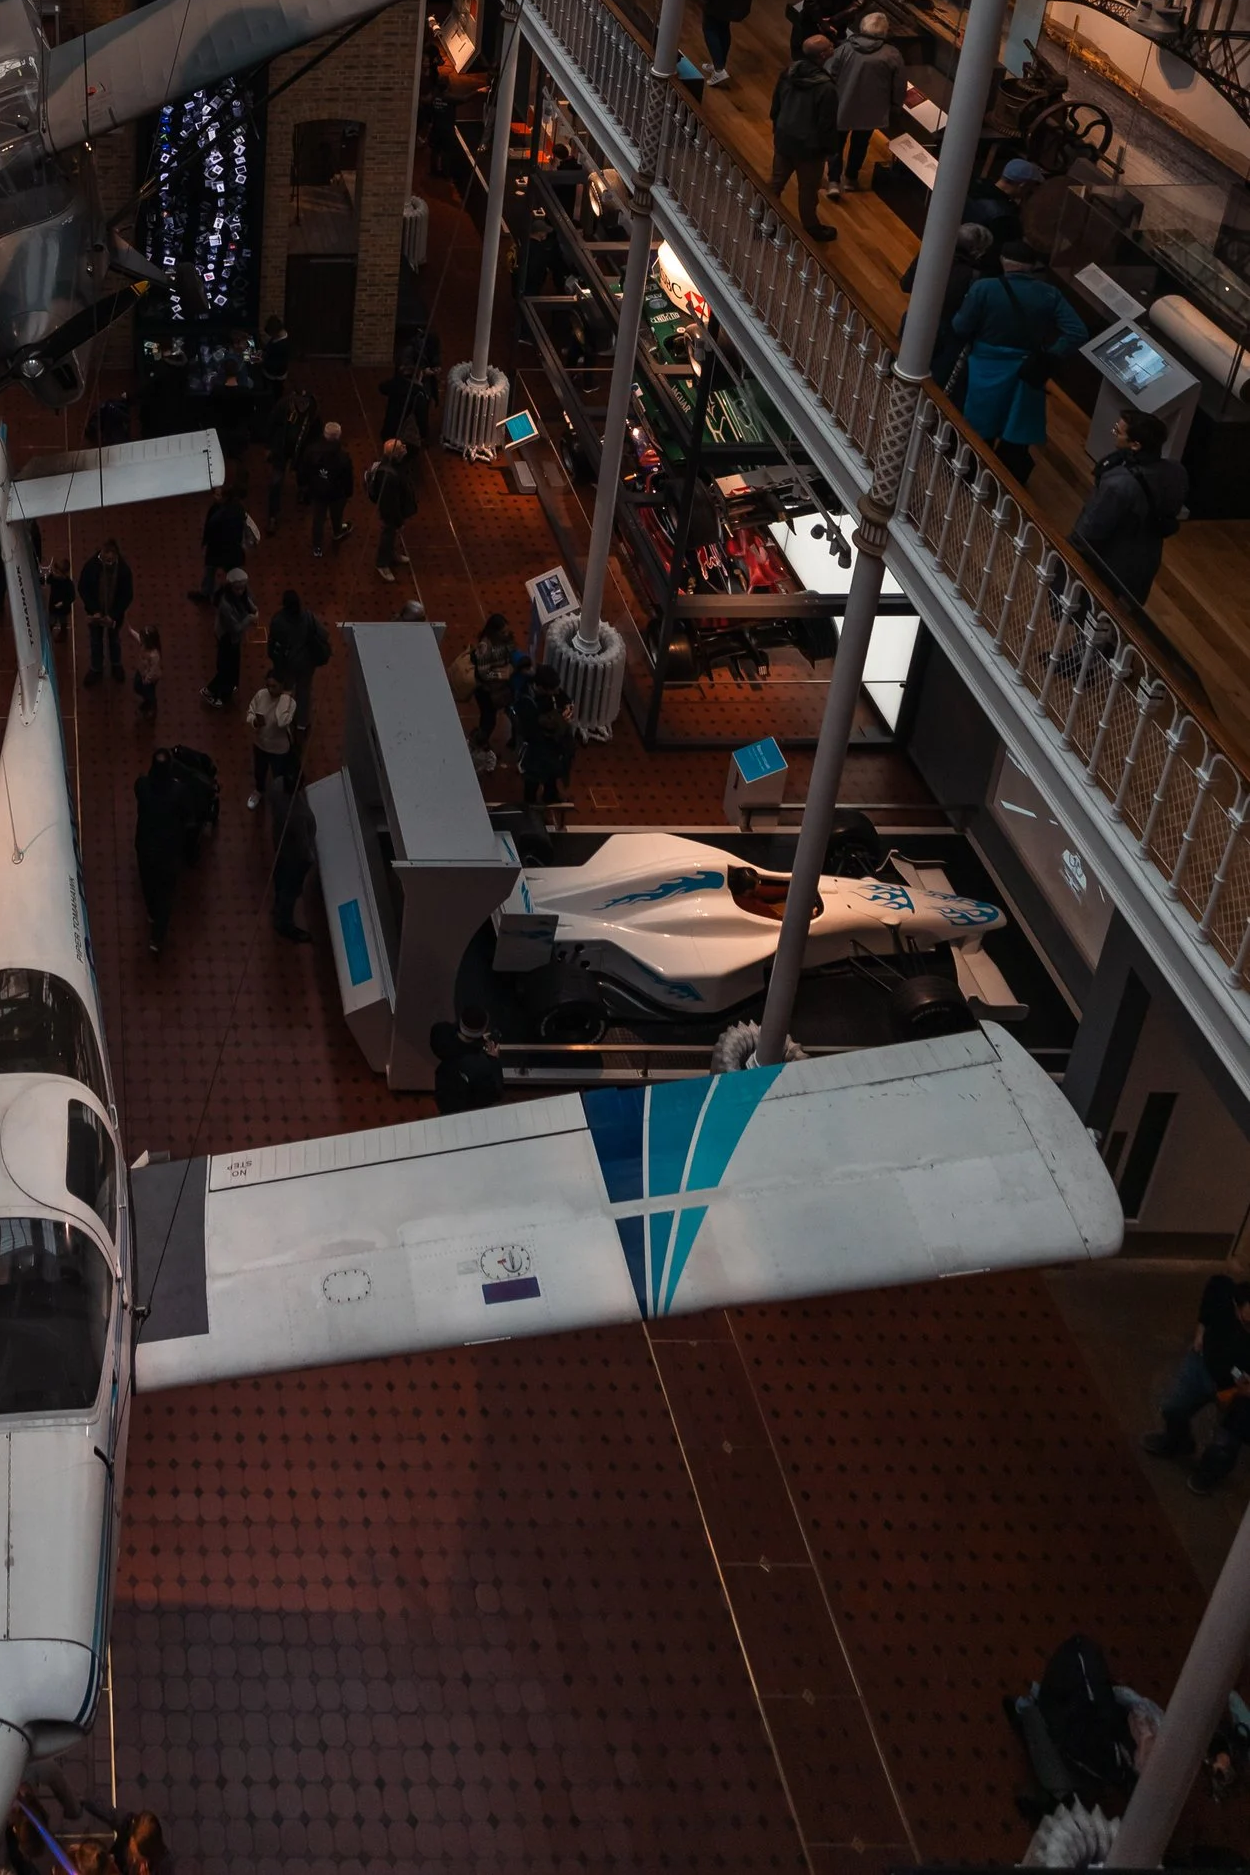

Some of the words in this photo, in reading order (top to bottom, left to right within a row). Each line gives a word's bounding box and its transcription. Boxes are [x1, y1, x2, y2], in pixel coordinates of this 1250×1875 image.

[671, 384, 692, 414] JAGUAR
[15, 565, 34, 647] TOMAHAWK
[68, 875, 80, 932] TOMAHAWK
[75, 930, 85, 964] PIPER
[227, 1160, 253, 1171] STEP
[231, 1169, 247, 1177] NO
